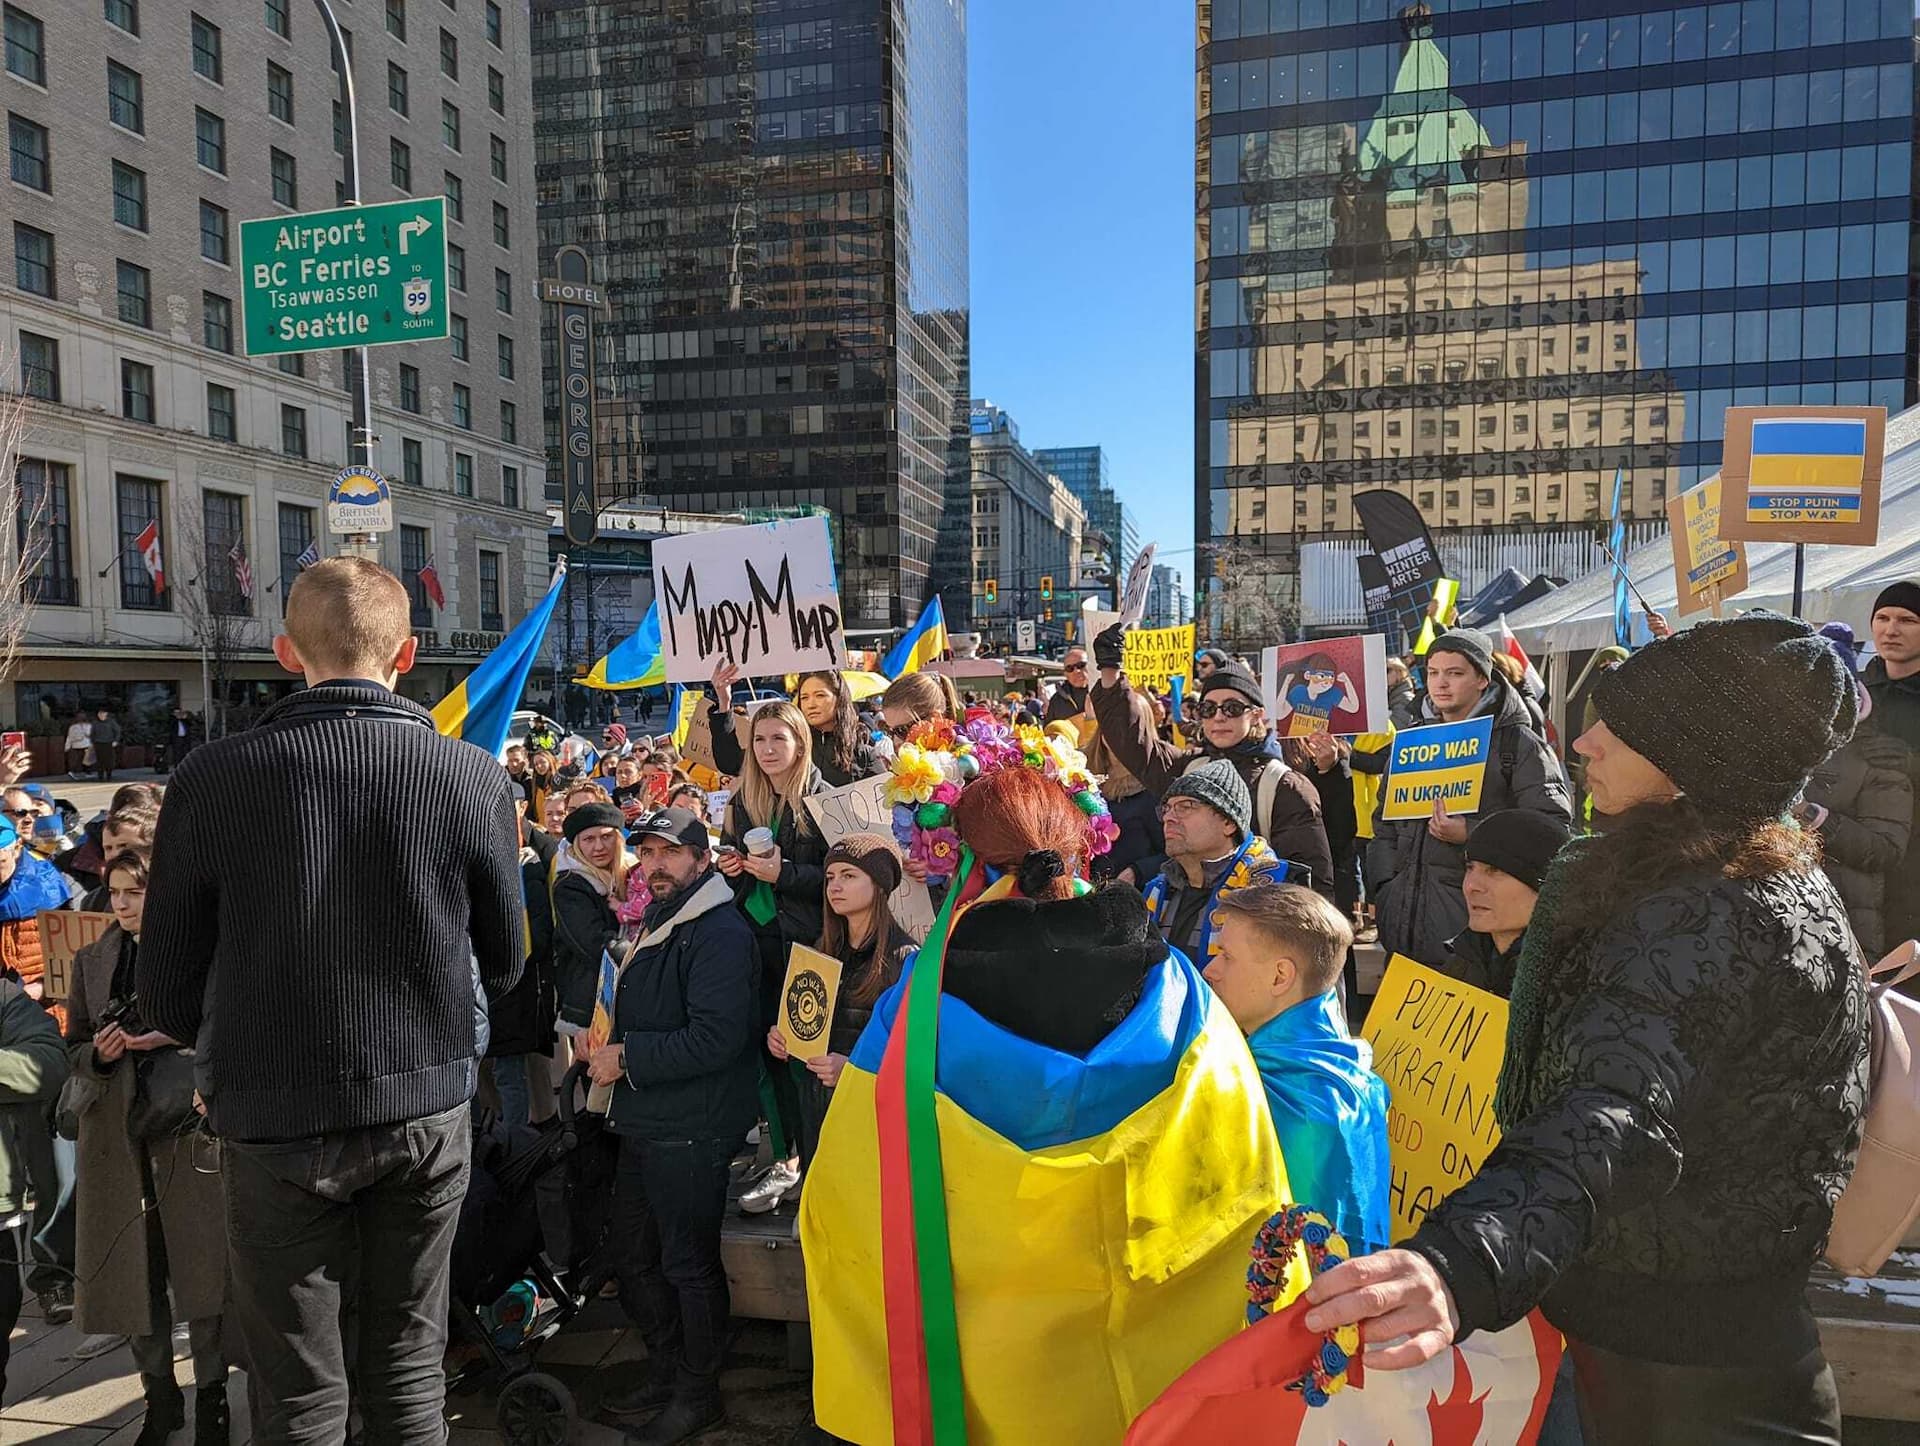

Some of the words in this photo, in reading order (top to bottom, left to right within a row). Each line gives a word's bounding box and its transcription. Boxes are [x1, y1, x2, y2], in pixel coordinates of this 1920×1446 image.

[275, 217, 366, 254] Airport
[254, 262, 288, 288] BC
[301, 254, 391, 284] Ferries
[411, 265, 422, 273] TO
[268, 283, 378, 308] Tsawwassen
[407, 292, 427, 306] 99
[549, 285, 601, 303] HOTEL
[279, 311, 370, 341] Seattle
[402, 320, 434, 329] SOUTH
[564, 314, 592, 514] GEORGIA
[360, 467, 385, 486] ROUTE
[340, 507, 380, 517] BRITISH
[1769, 497, 1801, 507] STOP
[1804, 498, 1840, 507] PUTIN
[333, 518, 387, 527] COLUMBIA
[1770, 510, 1801, 519] STOP
[1806, 510, 1838, 519] WAR
[1385, 551, 1431, 576] WINTER
[1391, 568, 1422, 589] ARTS
[450, 631, 506, 648] GEORGI
[1125, 630, 1189, 650] UKRAINE
[1123, 652, 1158, 671] EEDS
[1161, 651, 1191, 671] YOUR
[1398, 743, 1441, 765] STOP
[1445, 738, 1480, 760] WAR
[1394, 787, 1409, 803] IN
[1412, 780, 1473, 802] UKRAINE
[44, 913, 111, 955] PUT
[797, 978, 809, 990] NO
[808, 978, 825, 1001] WAR
